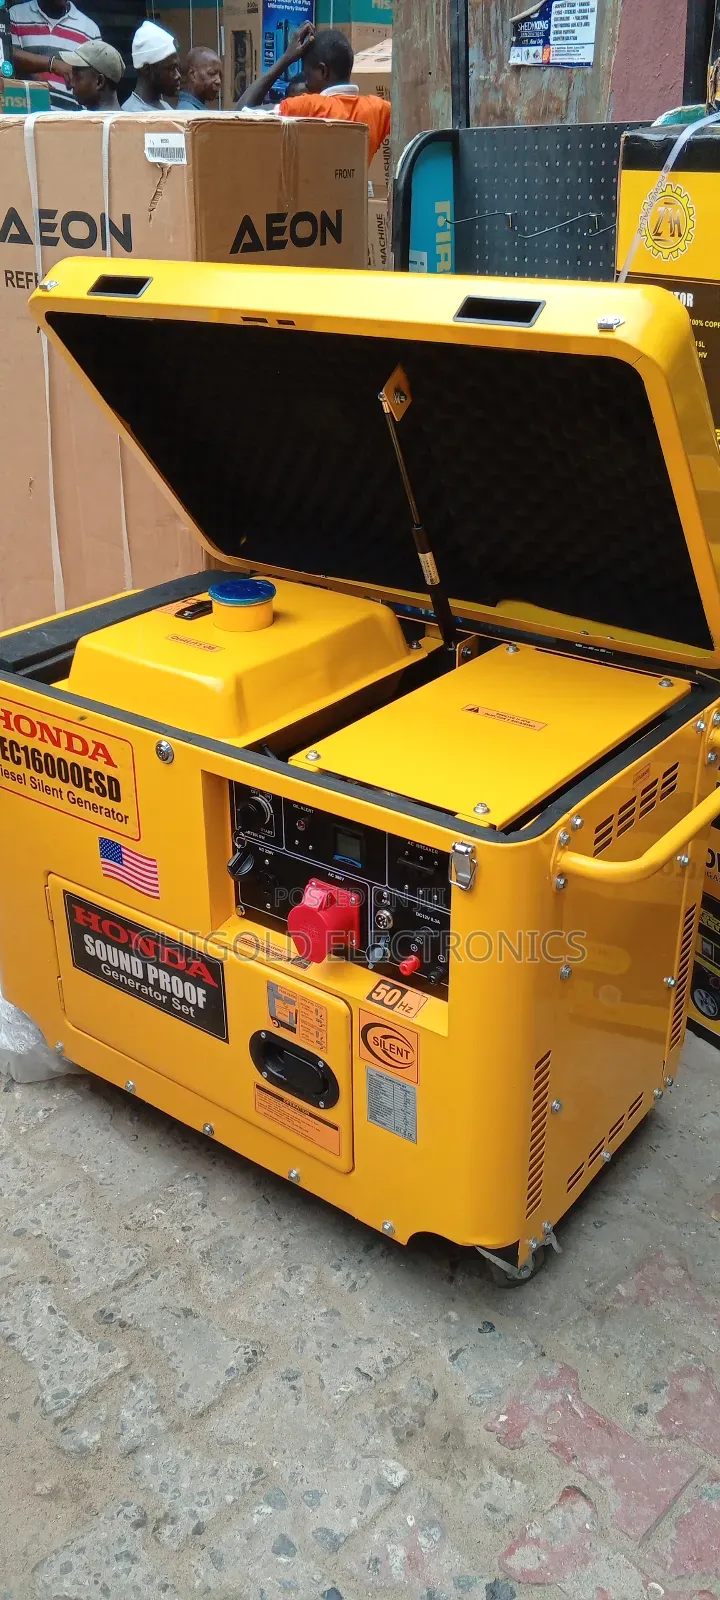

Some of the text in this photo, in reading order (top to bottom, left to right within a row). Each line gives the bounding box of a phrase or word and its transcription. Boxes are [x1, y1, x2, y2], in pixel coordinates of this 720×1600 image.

[334, 168, 355, 179] FRONT
[0, 207, 133, 252] AEON
[229, 209, 342, 255] AEON
[376, 214, 387, 265] MACHINE
[0, 764, 129, 825] iesel Silent Generator
[72, 904, 218, 988] HONDA
[83, 934, 207, 1009] SOUND PROOF
[101, 963, 196, 1018] Generator Set
[371, 983, 413, 1014] 50 Hz
[372, 1036, 411, 1060] SILENT
